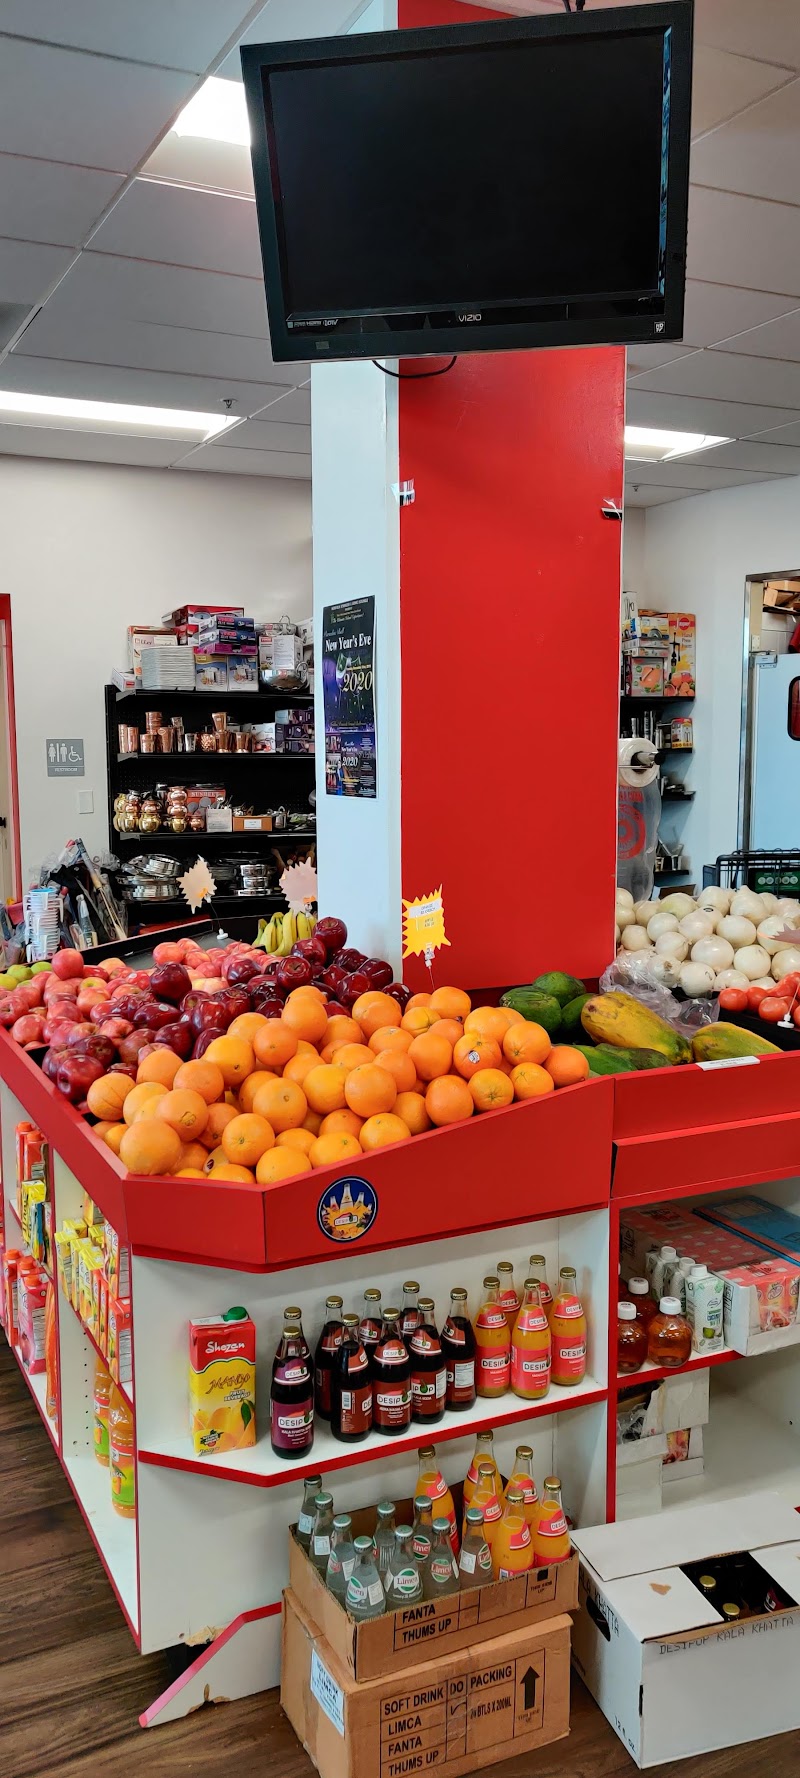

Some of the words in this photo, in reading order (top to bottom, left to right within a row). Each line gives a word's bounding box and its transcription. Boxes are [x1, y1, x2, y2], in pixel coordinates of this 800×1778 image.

[458, 314, 482, 322] VIZIO
[325, 640, 337, 652] New
[339, 635, 358, 650] Year's
[359, 633, 372, 646] Eve
[342, 670, 373, 692] 2020
[342, 757, 358, 766] 2020
[402, 1604, 435, 1623] FANTA
[403, 1624, 435, 1644] THUMS
[439, 1618, 451, 1632] UP
[717, 1627, 744, 1642] KALA
[752, 1616, 794, 1634] KHATTA
[384, 1697, 411, 1716] SOFT
[413, 1687, 444, 1707] DRINK
[450, 1681, 464, 1696] DO
[470, 1666, 512, 1688] PACKING
[477, 1706, 491, 1718] BTLS
[492, 1704, 496, 1712] X
[496, 1696, 512, 1711] 200ML
[388, 1716, 421, 1735] LIMCA
[388, 1736, 422, 1756] FANTA
[388, 1756, 422, 1777] THUMS
[426, 1750, 439, 1764] UP
